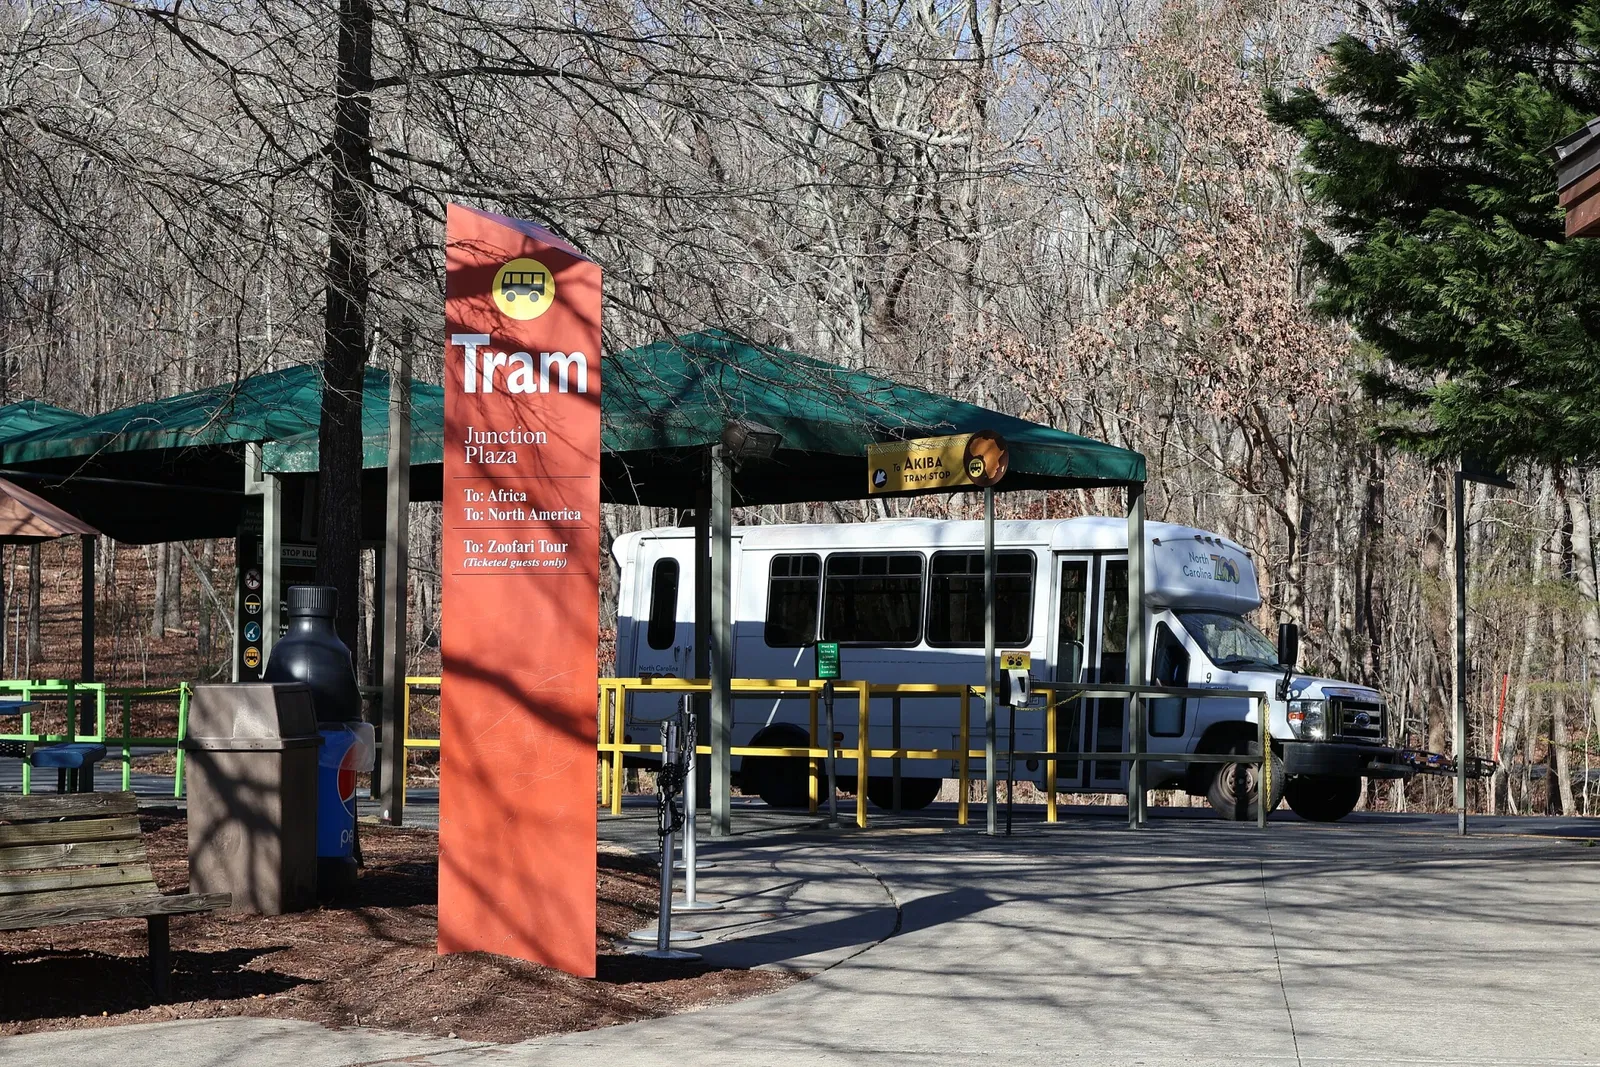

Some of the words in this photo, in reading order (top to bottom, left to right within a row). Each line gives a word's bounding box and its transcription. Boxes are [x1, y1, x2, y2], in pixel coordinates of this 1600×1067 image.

[451, 333, 588, 394] Tram
[464, 426, 548, 444] Junction
[464, 445, 518, 464] Plaza
[893, 463, 900, 472] To
[904, 457, 942, 470] AKIBA
[904, 474, 926, 482] TRAM
[929, 471, 951, 480] STOP
[464, 489, 484, 502] To:
[487, 489, 527, 502] Africa
[464, 508, 484, 521] To:
[488, 508, 525, 521] North
[528, 507, 581, 521] America
[282, 548, 301, 557] STOP
[302, 549, 317, 558] RUL
[464, 540, 484, 553] To:
[487, 539, 534, 554] Zoofari
[538, 540, 568, 553] Tour
[463, 558, 507, 568] (Ticketed
[510, 559, 540, 569] guests
[542, 558, 567, 568] only)
[1188, 552, 1209, 564] North
[1183, 565, 1212, 579] Carolina
[1210, 554, 1240, 584] ZOO
[1206, 672, 1212, 684] 9
[340, 829, 354, 849] pe
